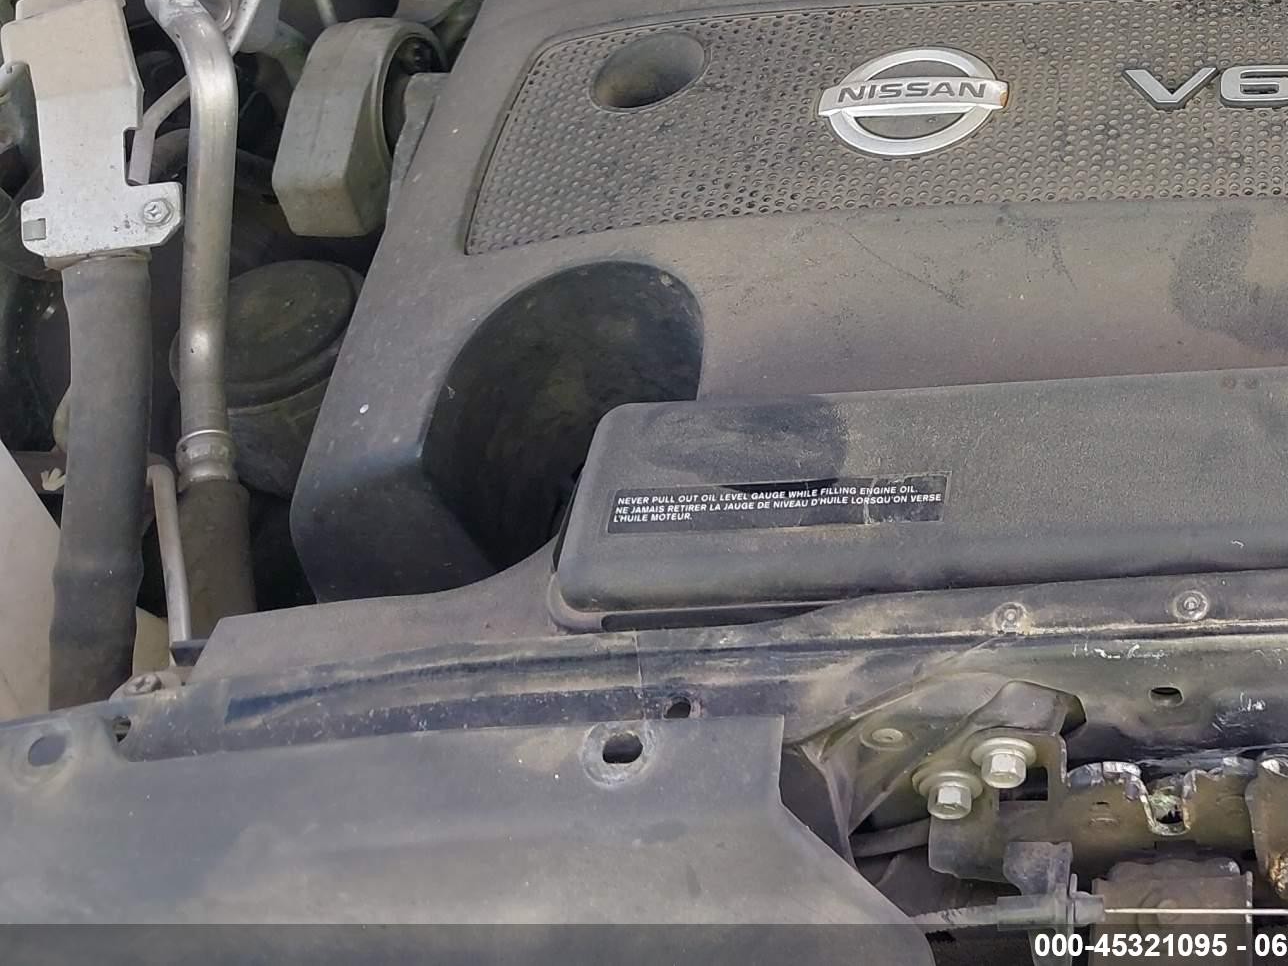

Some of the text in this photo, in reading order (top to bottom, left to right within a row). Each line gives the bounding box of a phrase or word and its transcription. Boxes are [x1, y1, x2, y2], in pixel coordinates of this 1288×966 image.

[837, 81, 987, 103] NISSAN
[615, 493, 942, 514] NE JAMAIS RETIRER LA JAUGE DE NIVEAU D'HUILE LORSQU'ON VERSE
[617, 485, 918, 505] NEVER PULL OUT OIL LEVEL GAUGE WHILE FILLING ENGINE OIL.
[613, 513, 693, 523] L'HUILE MOTEUR.
